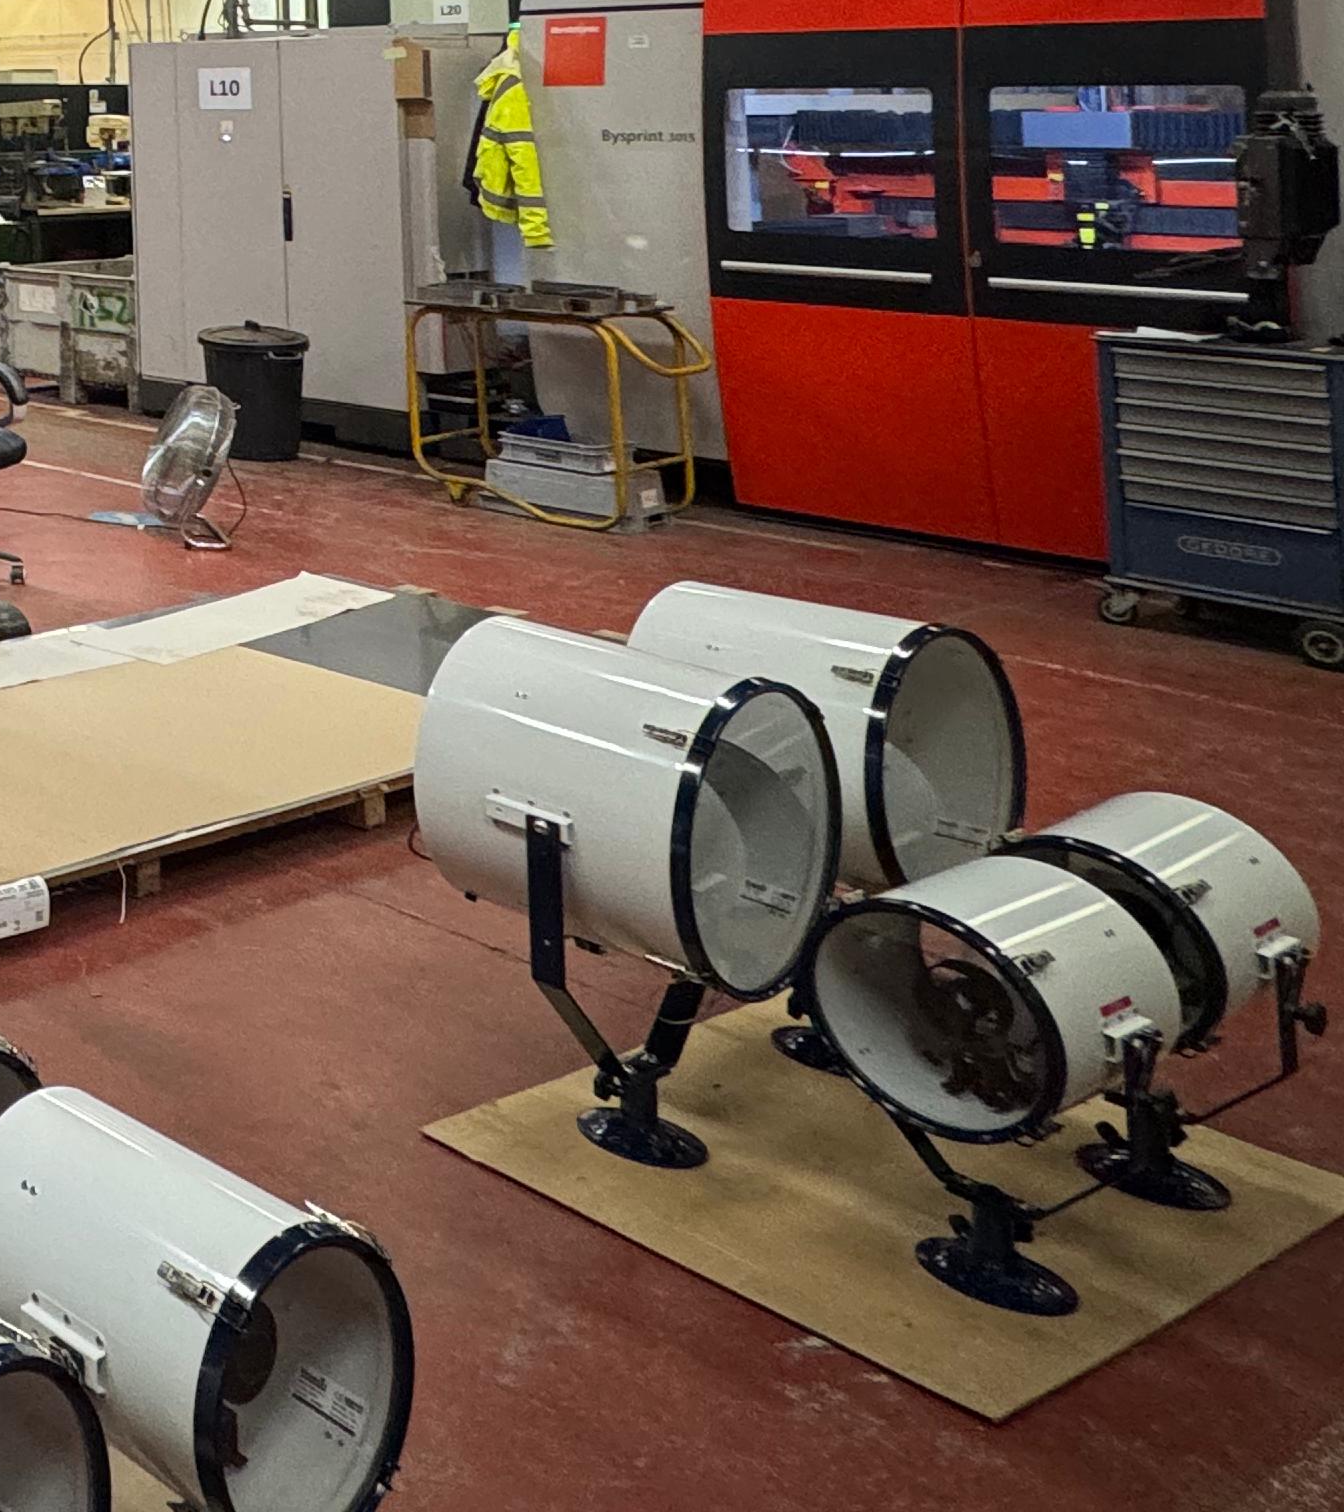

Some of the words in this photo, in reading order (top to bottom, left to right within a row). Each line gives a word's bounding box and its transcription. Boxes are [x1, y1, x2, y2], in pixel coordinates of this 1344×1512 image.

[439, 4, 462, 16] L20
[209, 79, 240, 96] L10
[602, 129, 665, 145] Bysprint
